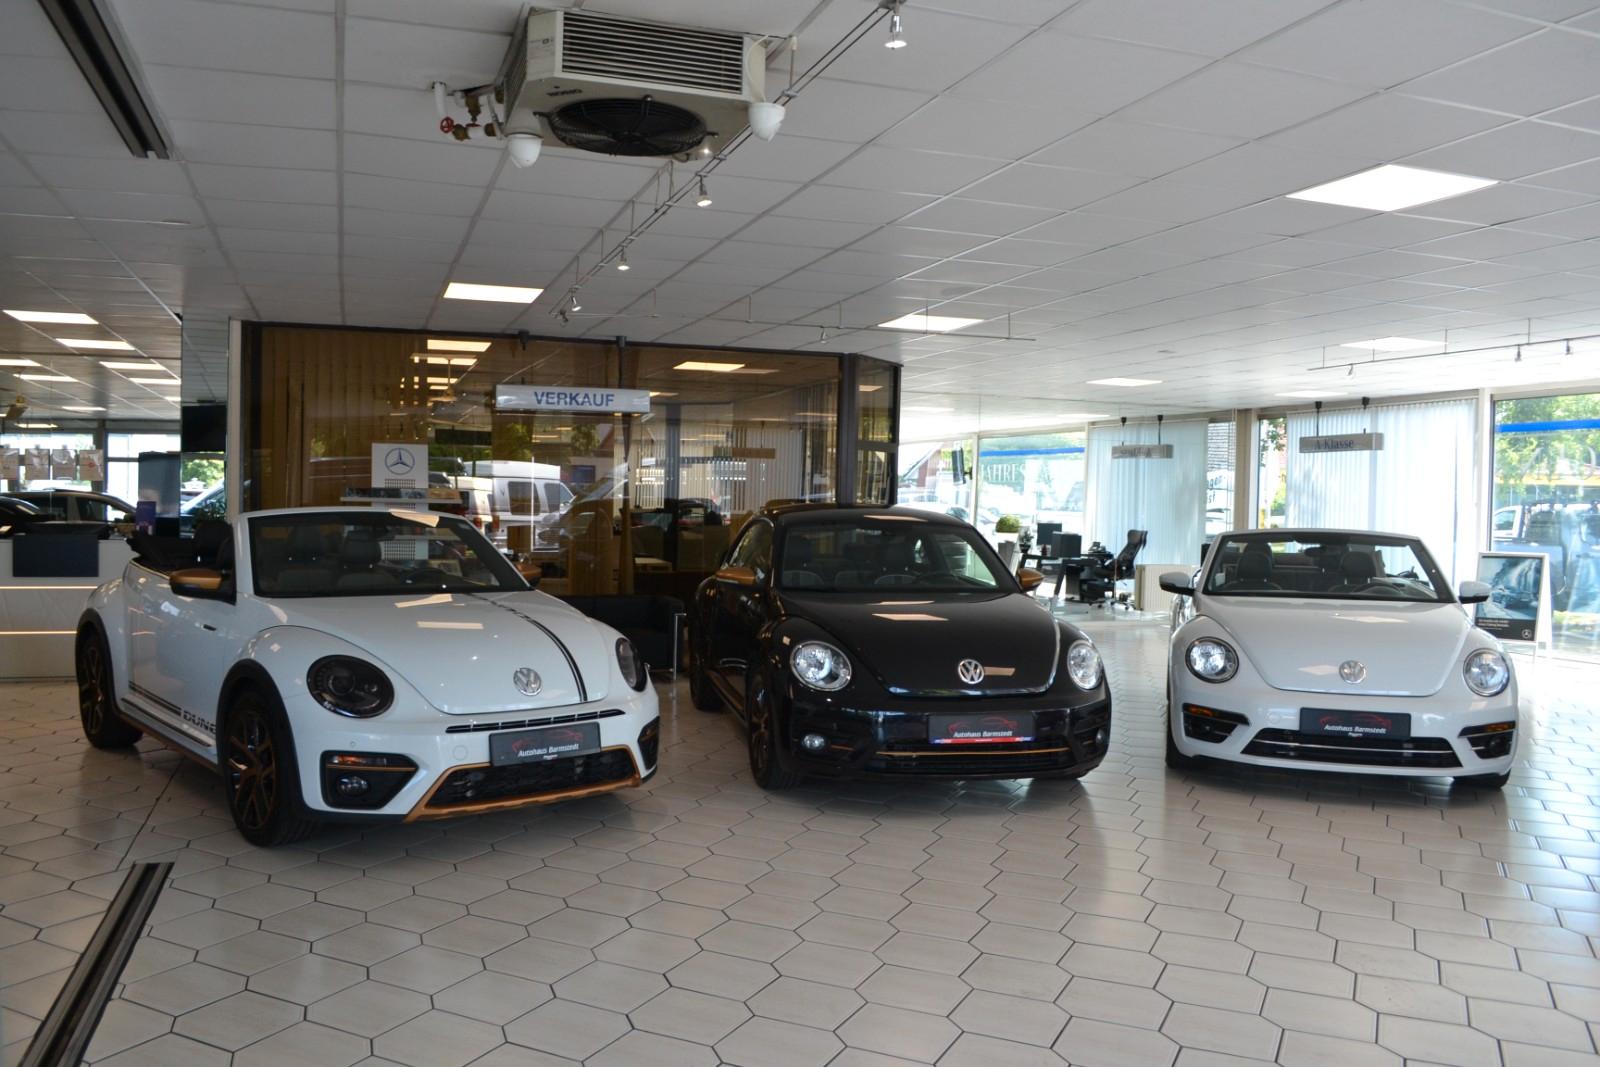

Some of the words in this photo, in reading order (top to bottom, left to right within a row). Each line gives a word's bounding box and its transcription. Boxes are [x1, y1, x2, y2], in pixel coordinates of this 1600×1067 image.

[534, 391, 615, 407] VERKAUF
[1324, 724, 1353, 732] Autohaus
[517, 747, 547, 757] Autohaus
